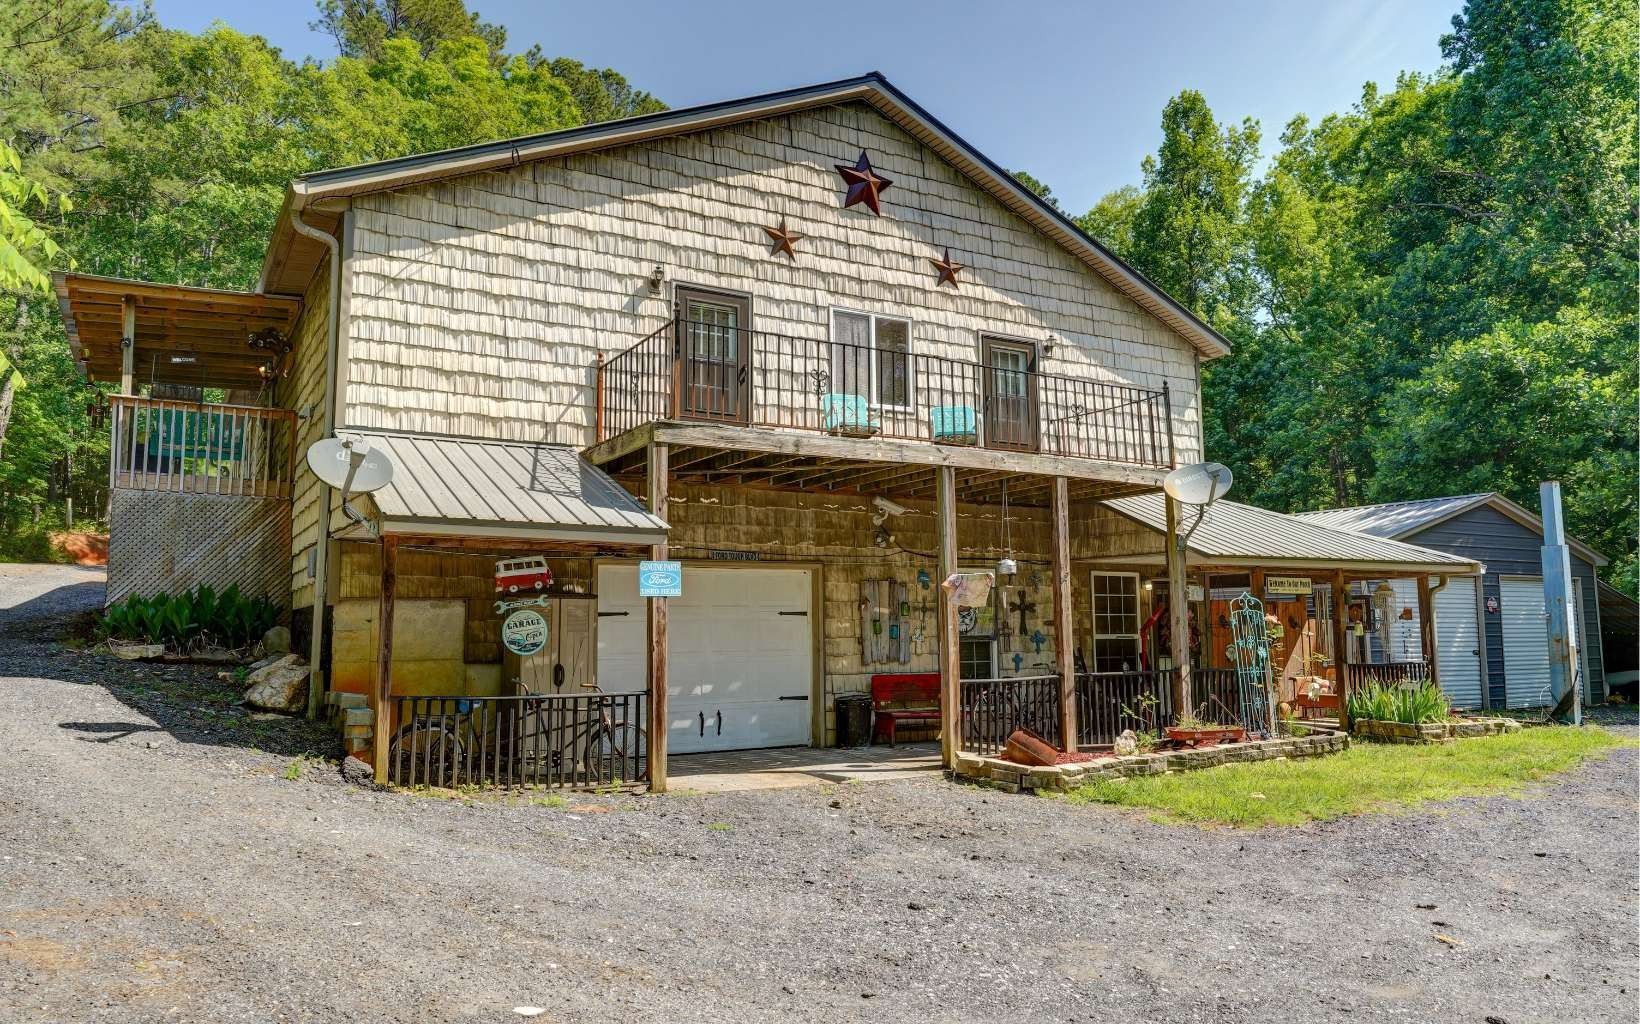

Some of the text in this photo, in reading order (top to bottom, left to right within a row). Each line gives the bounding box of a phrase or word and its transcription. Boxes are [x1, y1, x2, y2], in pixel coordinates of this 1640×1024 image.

[640, 562, 663, 571] GENUINE
[649, 572, 671, 584] Ford
[507, 619, 541, 630] GARAGE
